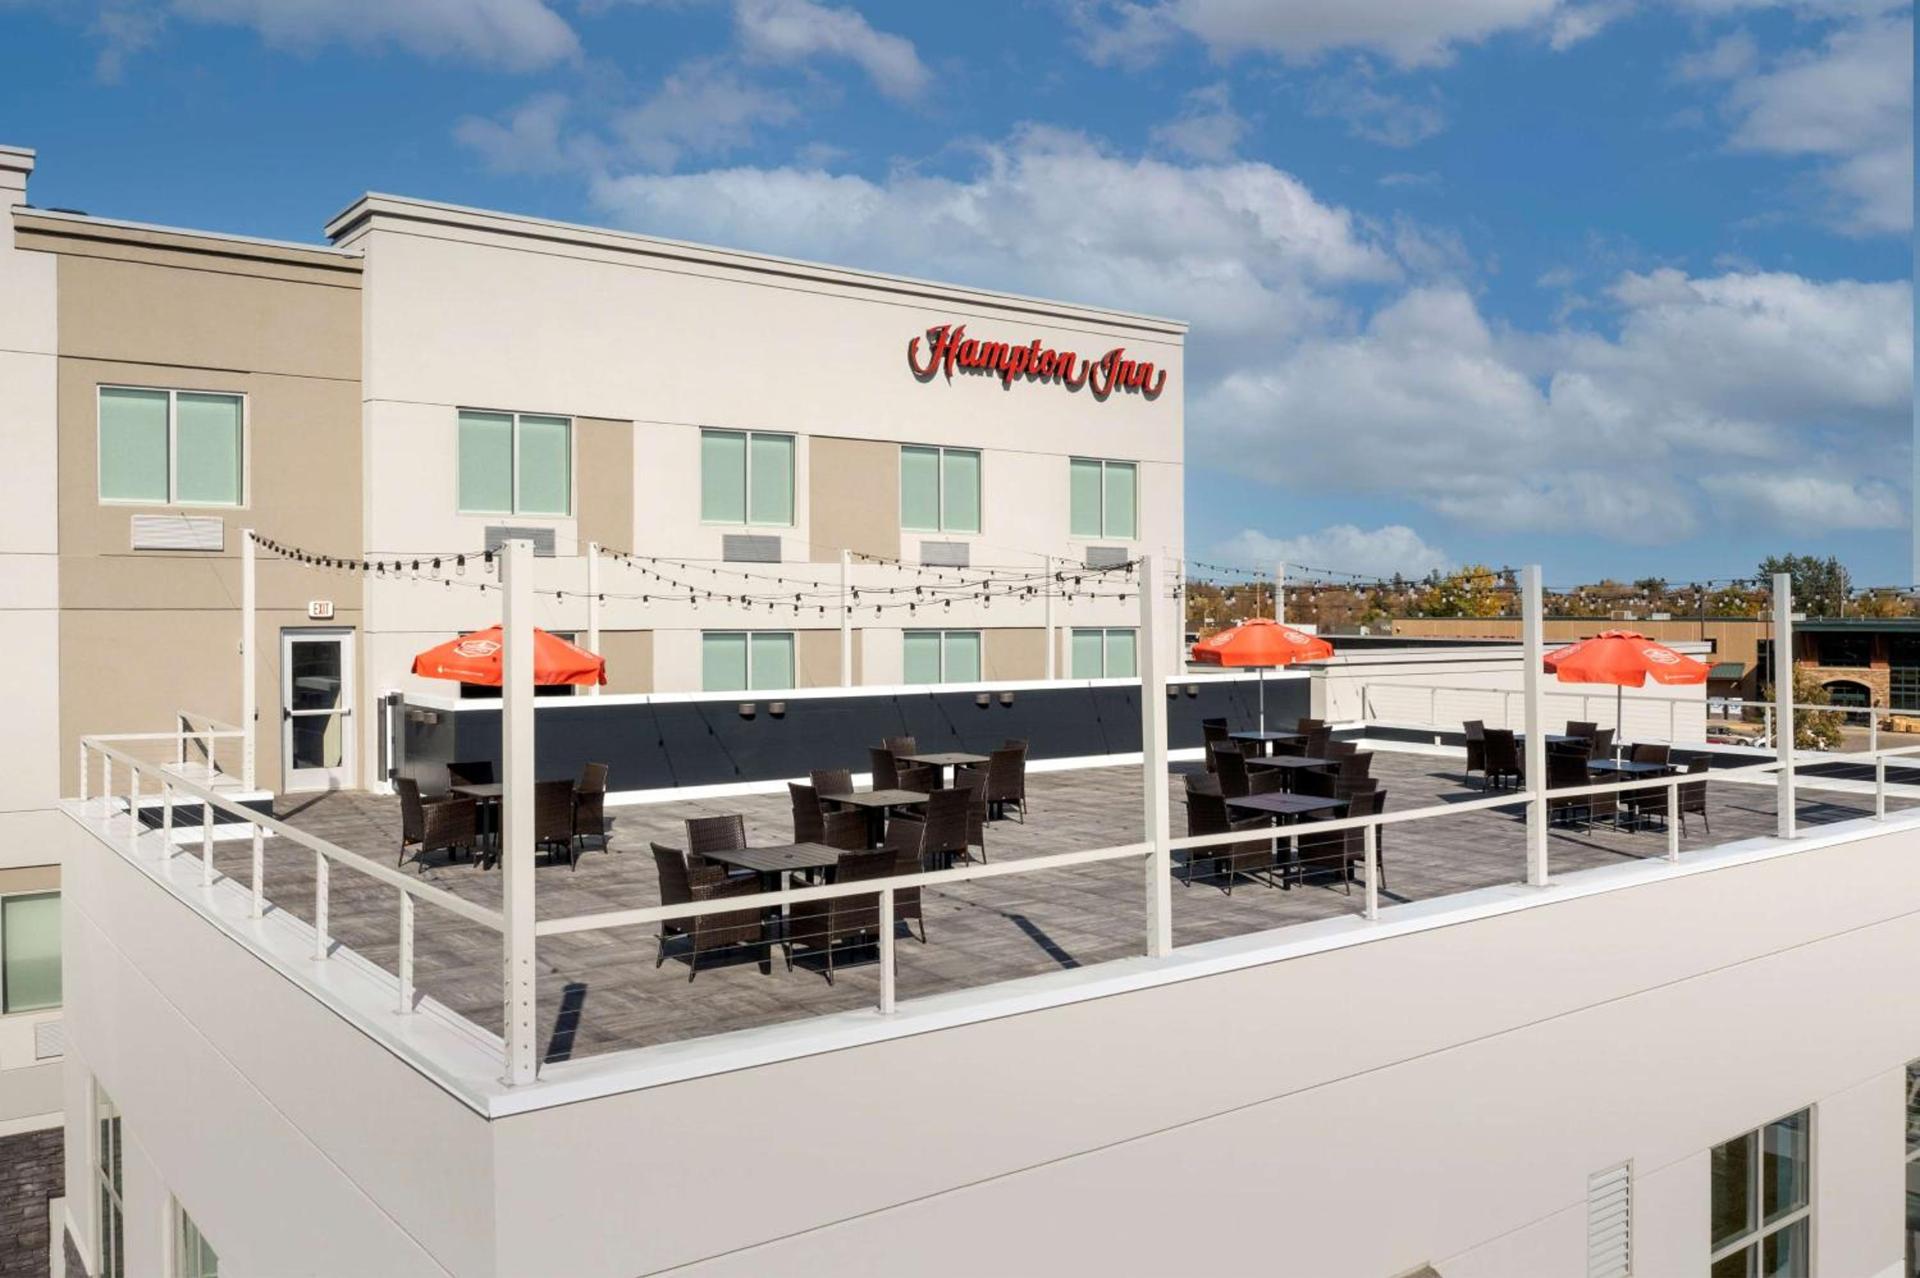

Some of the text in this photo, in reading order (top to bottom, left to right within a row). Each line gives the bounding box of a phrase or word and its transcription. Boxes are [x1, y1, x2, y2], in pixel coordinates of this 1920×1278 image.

[908, 324, 1167, 398] Hampton Inn
[313, 602, 329, 615] EXIT
